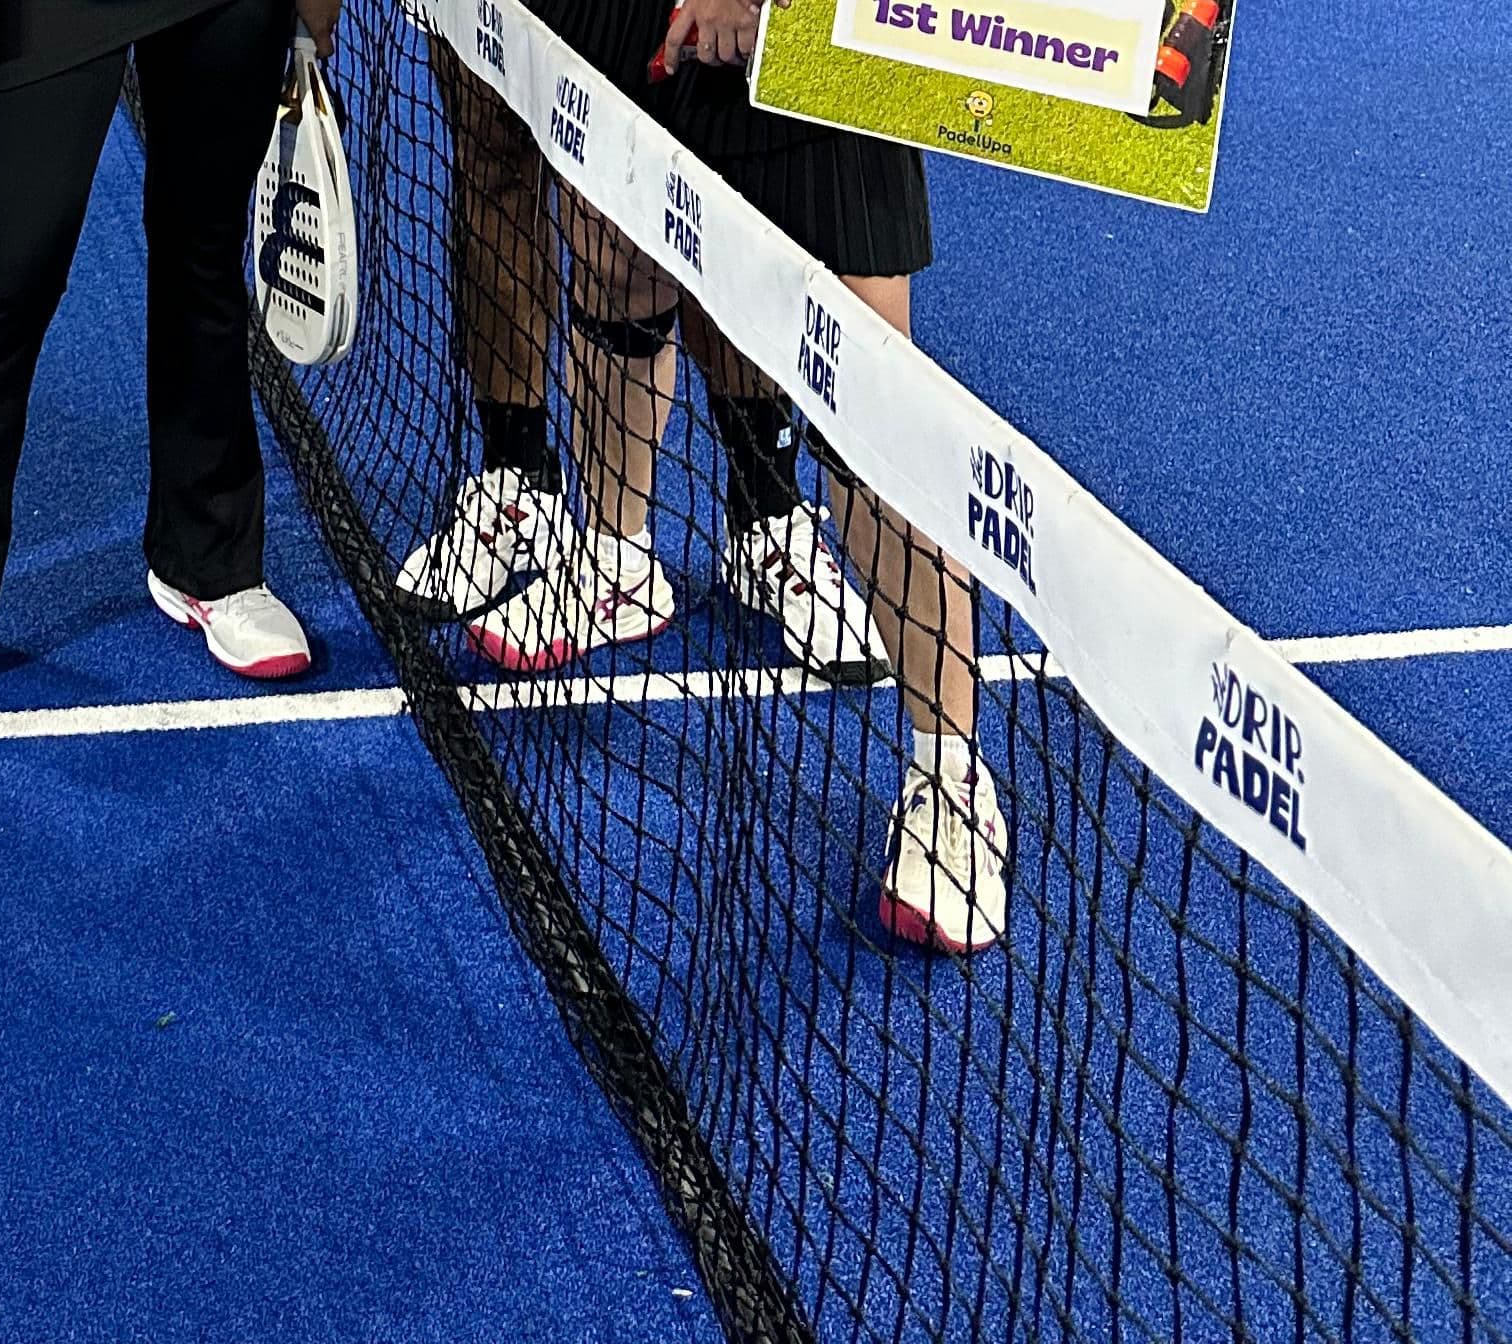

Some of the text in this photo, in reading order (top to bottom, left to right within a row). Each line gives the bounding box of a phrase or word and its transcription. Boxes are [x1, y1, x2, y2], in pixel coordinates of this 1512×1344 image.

[477, 27, 506, 76] PADEL
[951, 9, 1118, 73] Winner
[561, 76, 590, 128] DRIP.
[550, 107, 585, 166] PADEL
[938, 126, 1012, 155] PadelUpa
[675, 174, 702, 233] DRIP.
[665, 207, 703, 275] PADEL
[805, 294, 841, 366] DRIP.
[798, 332, 837, 415] PADEL
[984, 450, 1034, 539] DRIP.
[968, 491, 1037, 597] PADEL
[1223, 668, 1305, 786] DRIP.
[1194, 714, 1307, 855] PADEL
